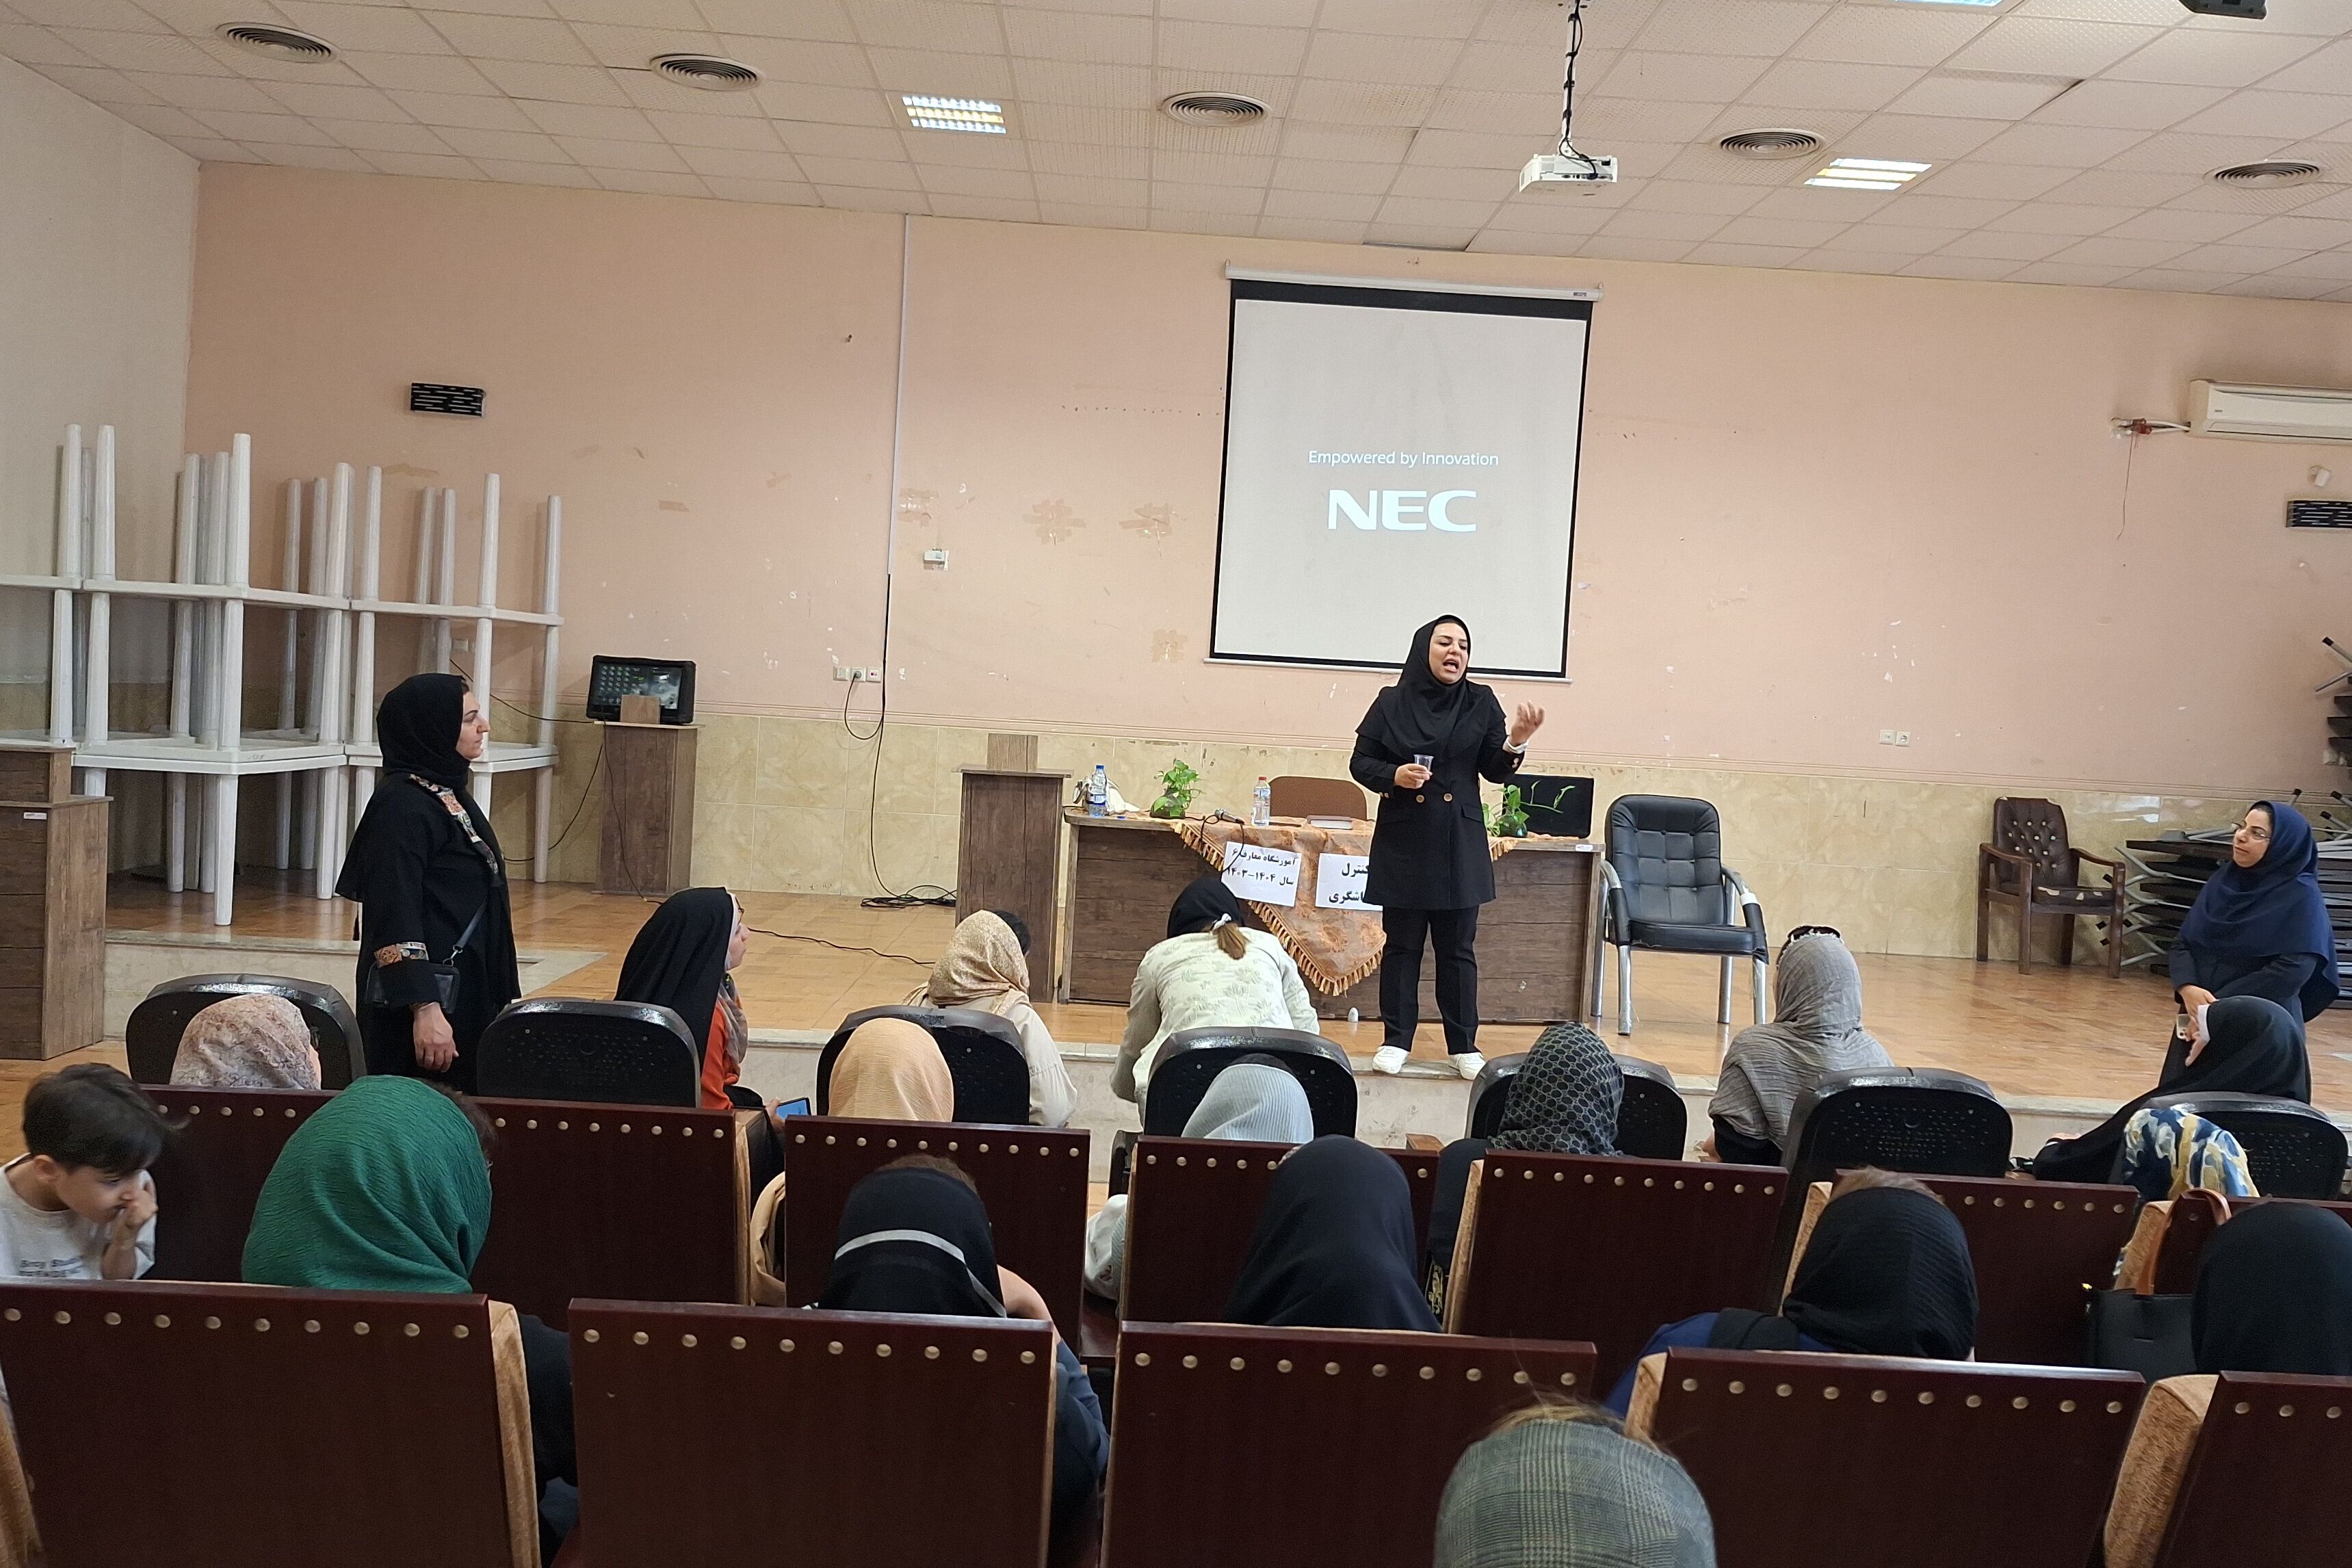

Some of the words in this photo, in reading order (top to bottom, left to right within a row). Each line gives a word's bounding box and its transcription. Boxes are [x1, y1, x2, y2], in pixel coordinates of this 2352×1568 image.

[1308, 450, 1396, 467] Empowered
[1400, 452, 1418, 468] by
[1422, 452, 1499, 467] Innovation
[1328, 488, 1477, 532] NEC
[1279, 876, 1294, 885] سال
